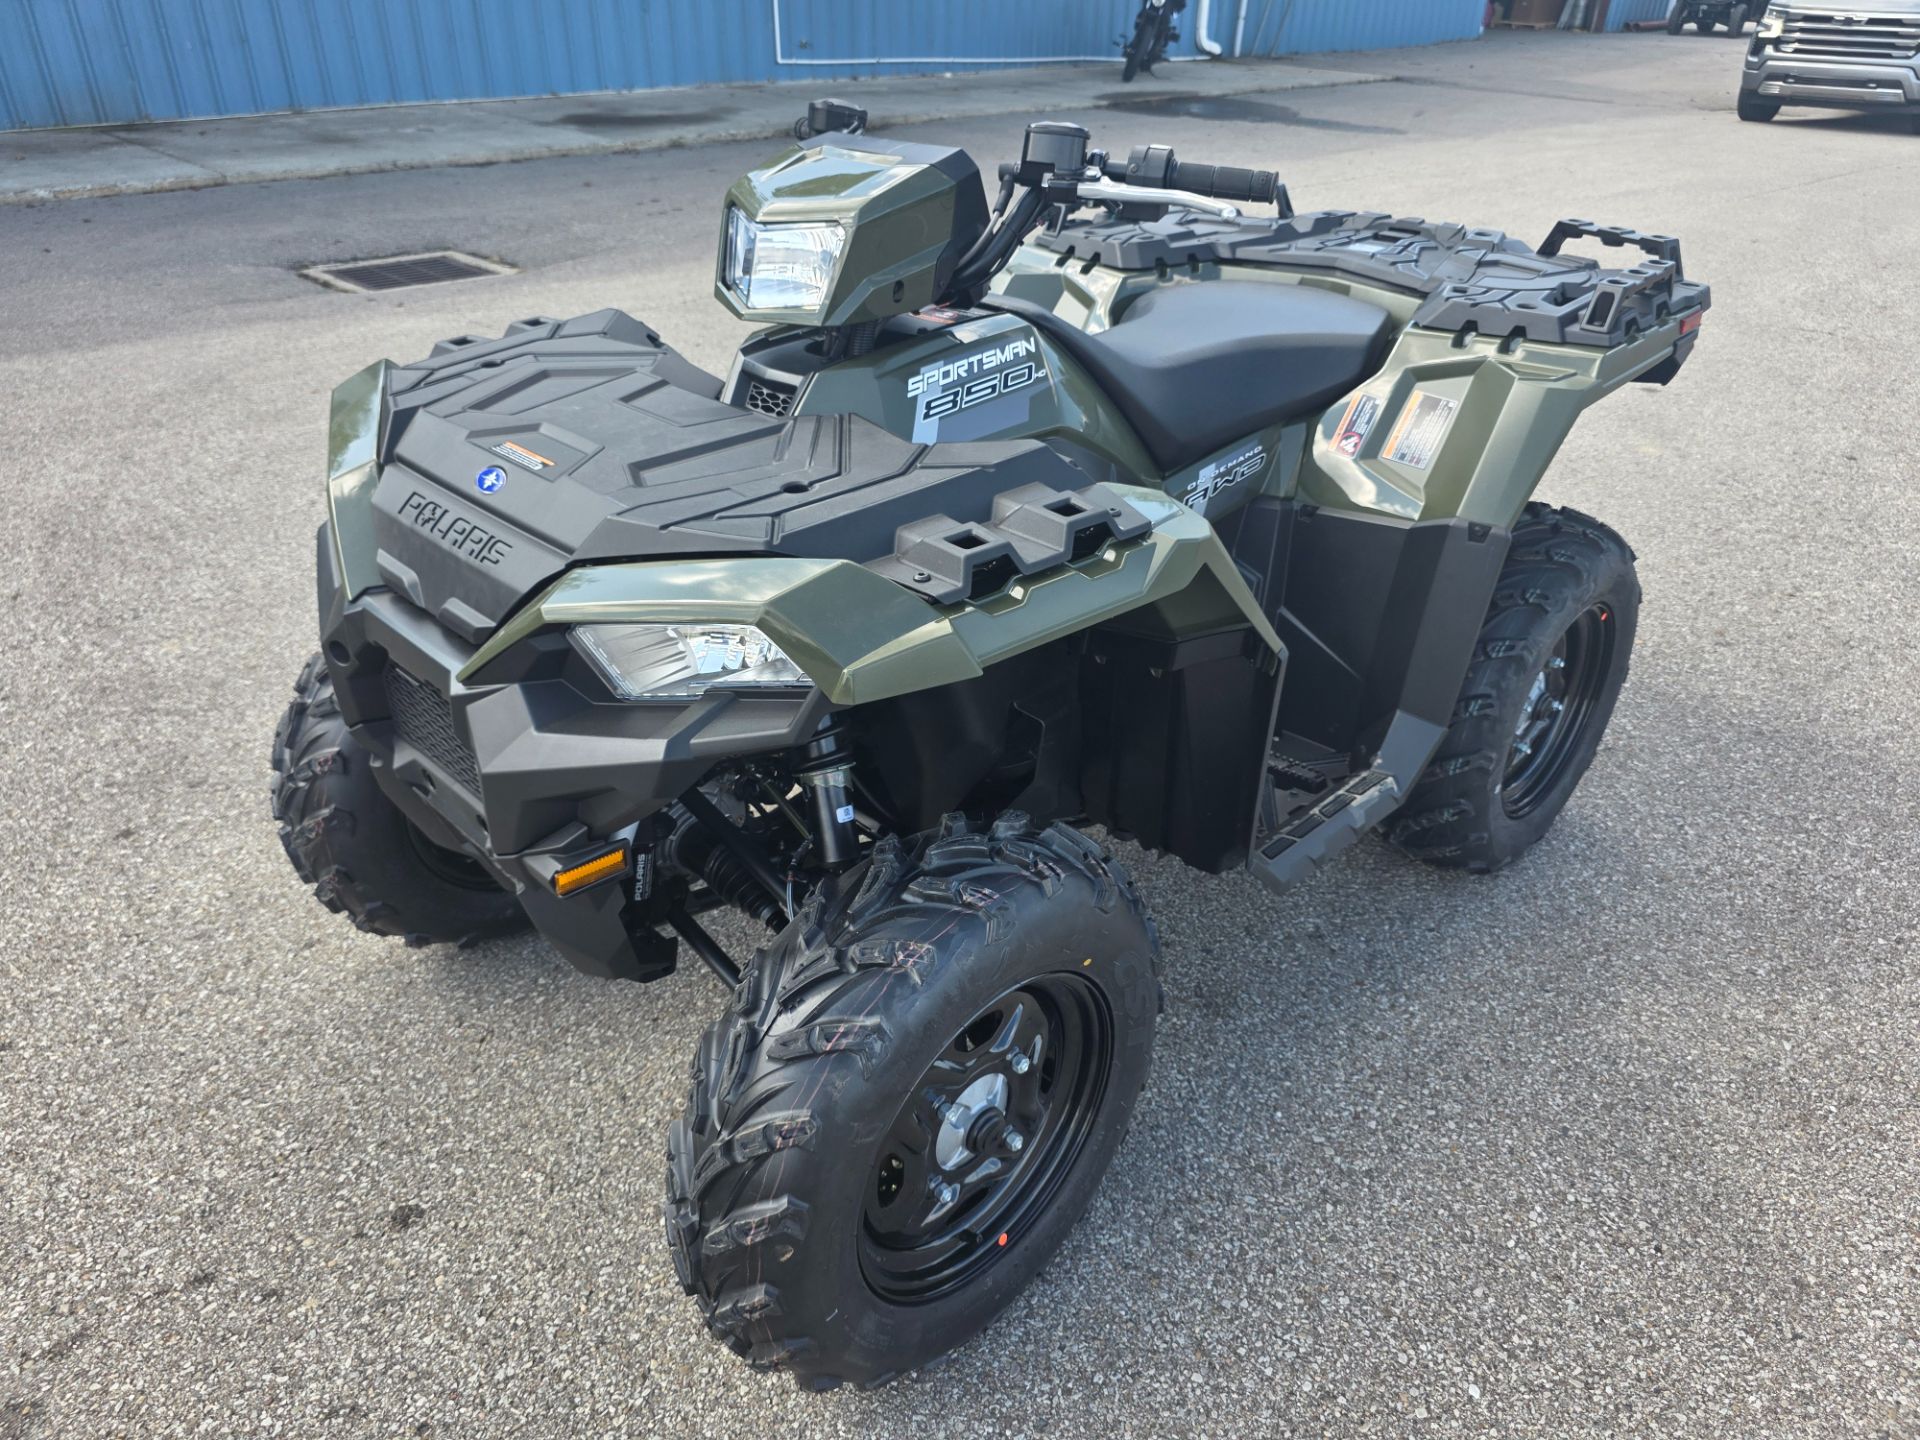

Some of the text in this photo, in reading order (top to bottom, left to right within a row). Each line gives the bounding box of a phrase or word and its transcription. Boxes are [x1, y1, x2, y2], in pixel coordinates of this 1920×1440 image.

[907, 336, 1036, 399] SPORTSMAN
[921, 361, 1035, 421] 850
[1183, 453, 1266, 509] AWD
[1187, 446, 1263, 491] ON DEMAND
[398, 491, 513, 565] POLARIS
[634, 853, 646, 901] POLARIS
